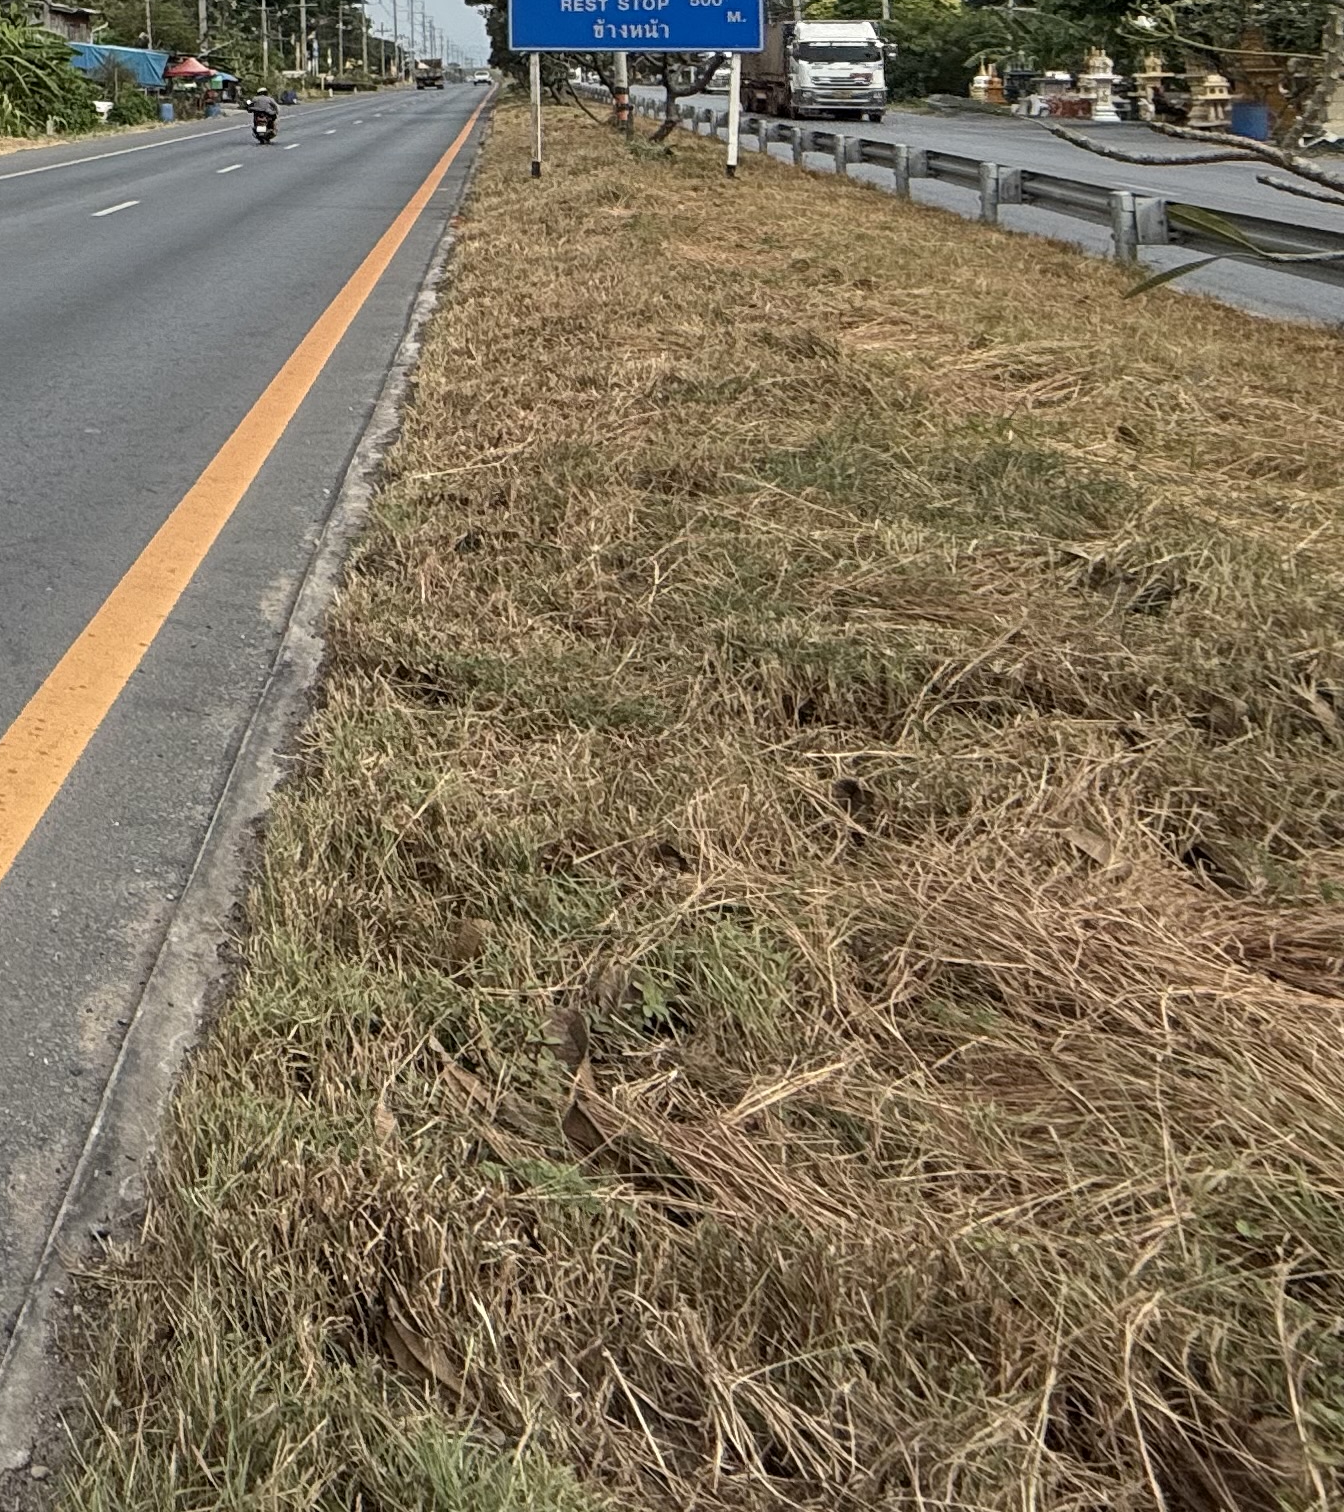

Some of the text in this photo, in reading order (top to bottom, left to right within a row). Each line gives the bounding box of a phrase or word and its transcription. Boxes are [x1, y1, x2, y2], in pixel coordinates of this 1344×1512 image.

[726, 10, 747, 23] M.
[592, 18, 671, 39] ข้างหน้า
